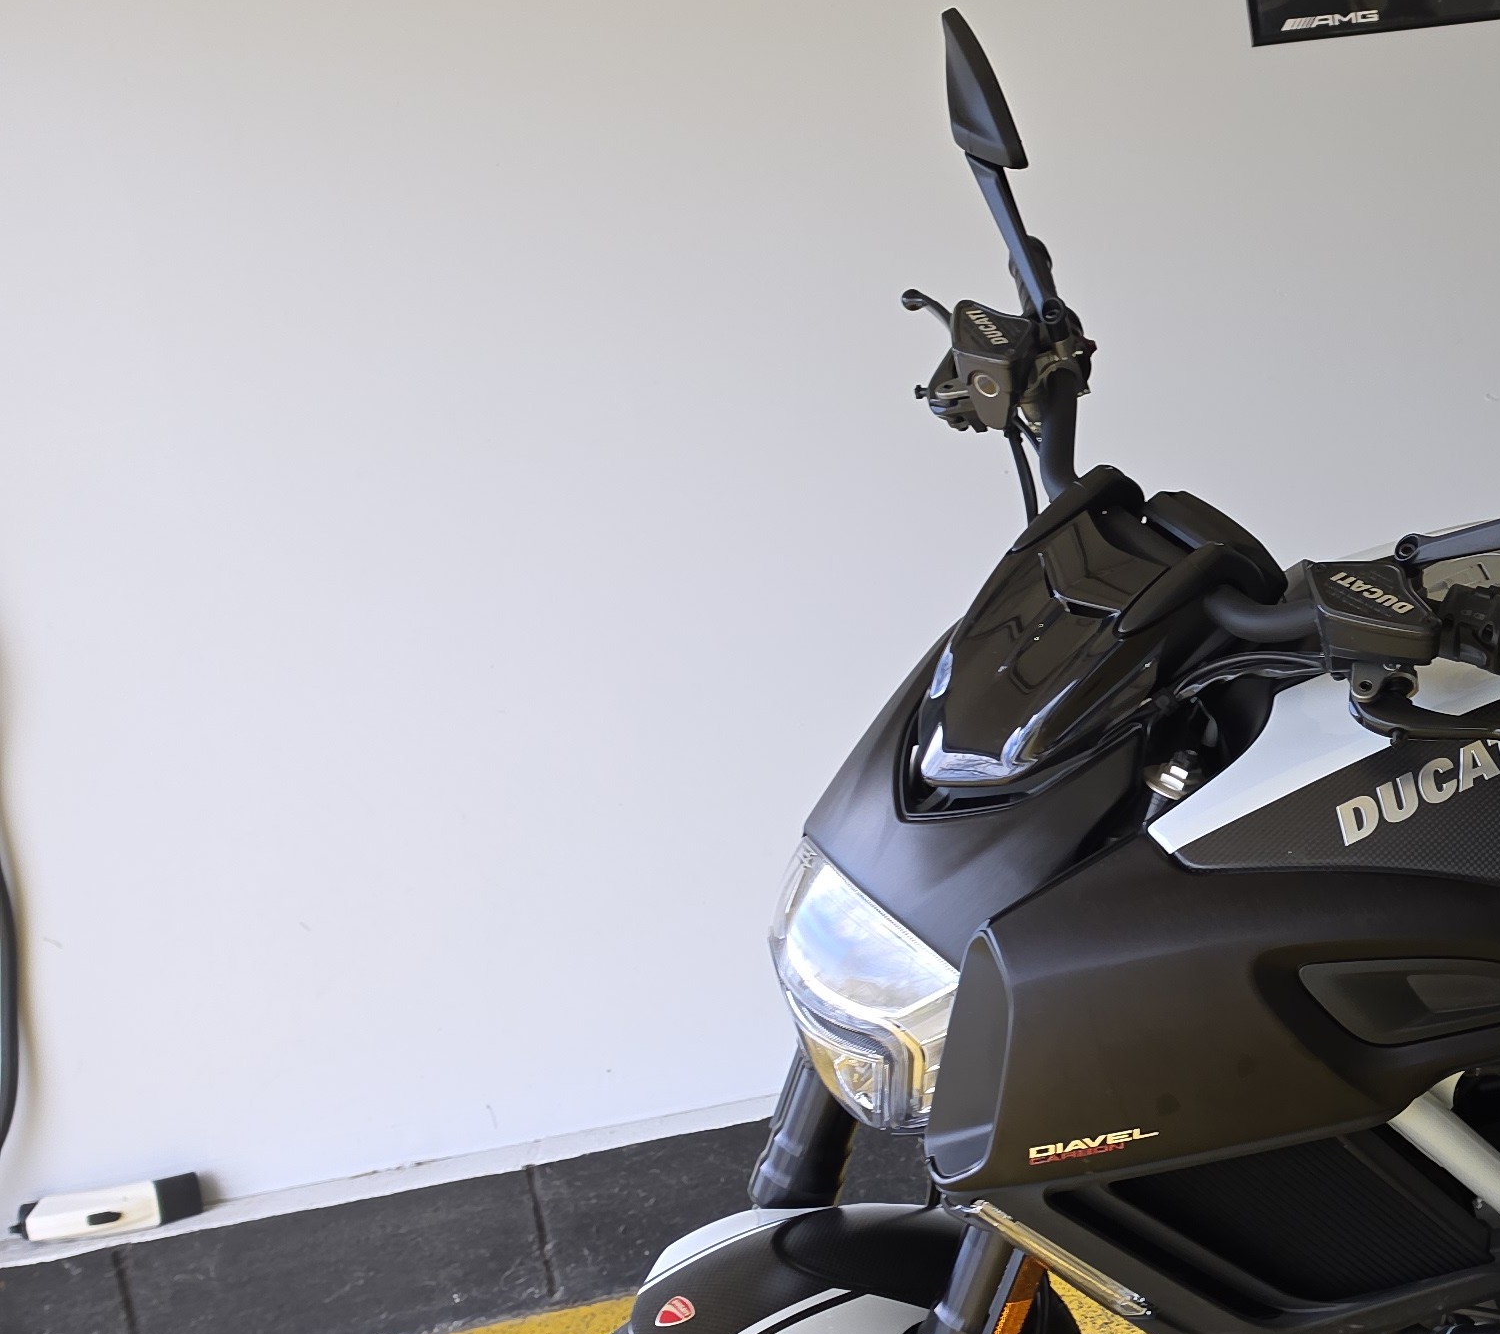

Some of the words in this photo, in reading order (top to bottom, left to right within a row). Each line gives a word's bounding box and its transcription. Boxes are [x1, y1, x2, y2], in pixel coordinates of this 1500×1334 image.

[1311, 10, 1379, 28] AMG
[965, 310, 1009, 345] DUCATI
[1329, 571, 1415, 615] DUCATI
[1029, 1128, 1160, 1159] DIAVEL
